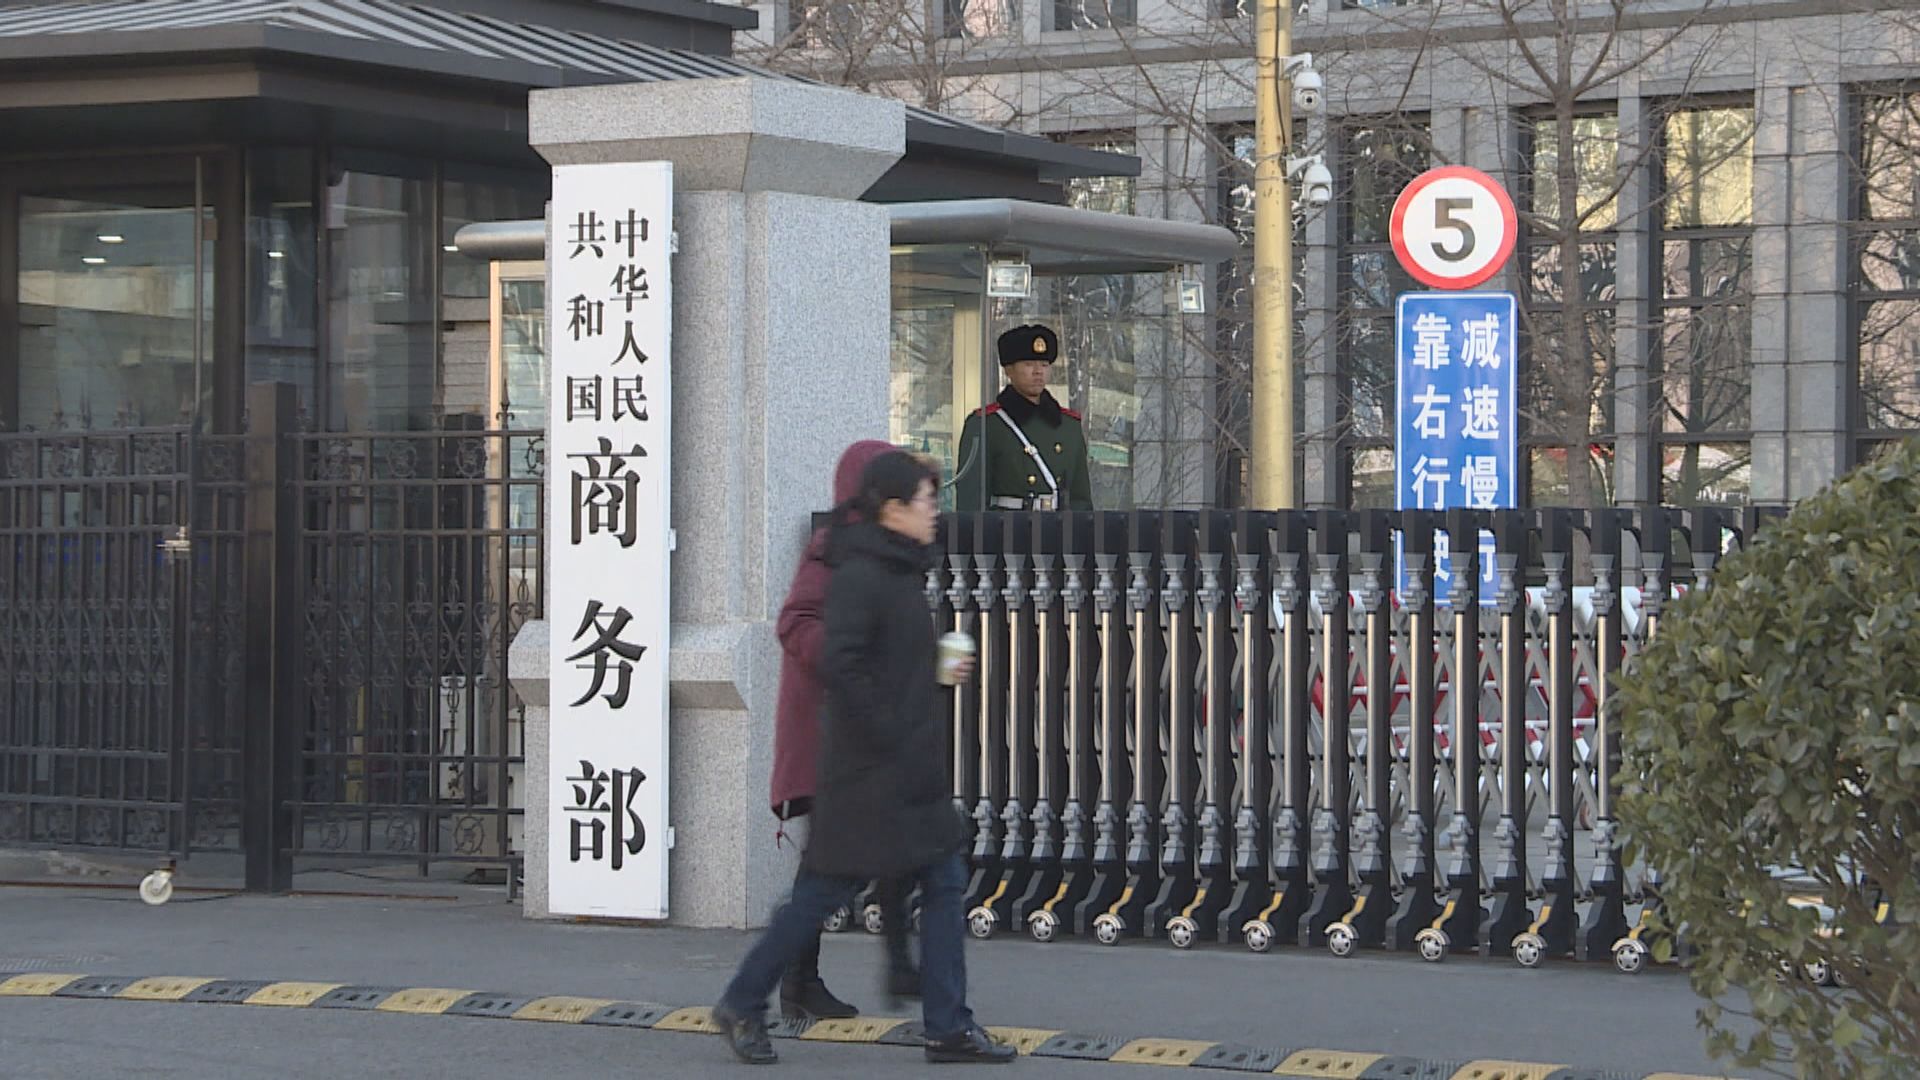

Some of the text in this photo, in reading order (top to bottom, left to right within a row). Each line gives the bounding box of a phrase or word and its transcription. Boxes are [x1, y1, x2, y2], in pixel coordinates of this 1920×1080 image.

[566, 211, 606, 422] 共和国
[610, 208, 649, 422] 中华人民
[1431, 198, 1476, 262] 5
[563, 436, 648, 871] 商务部
